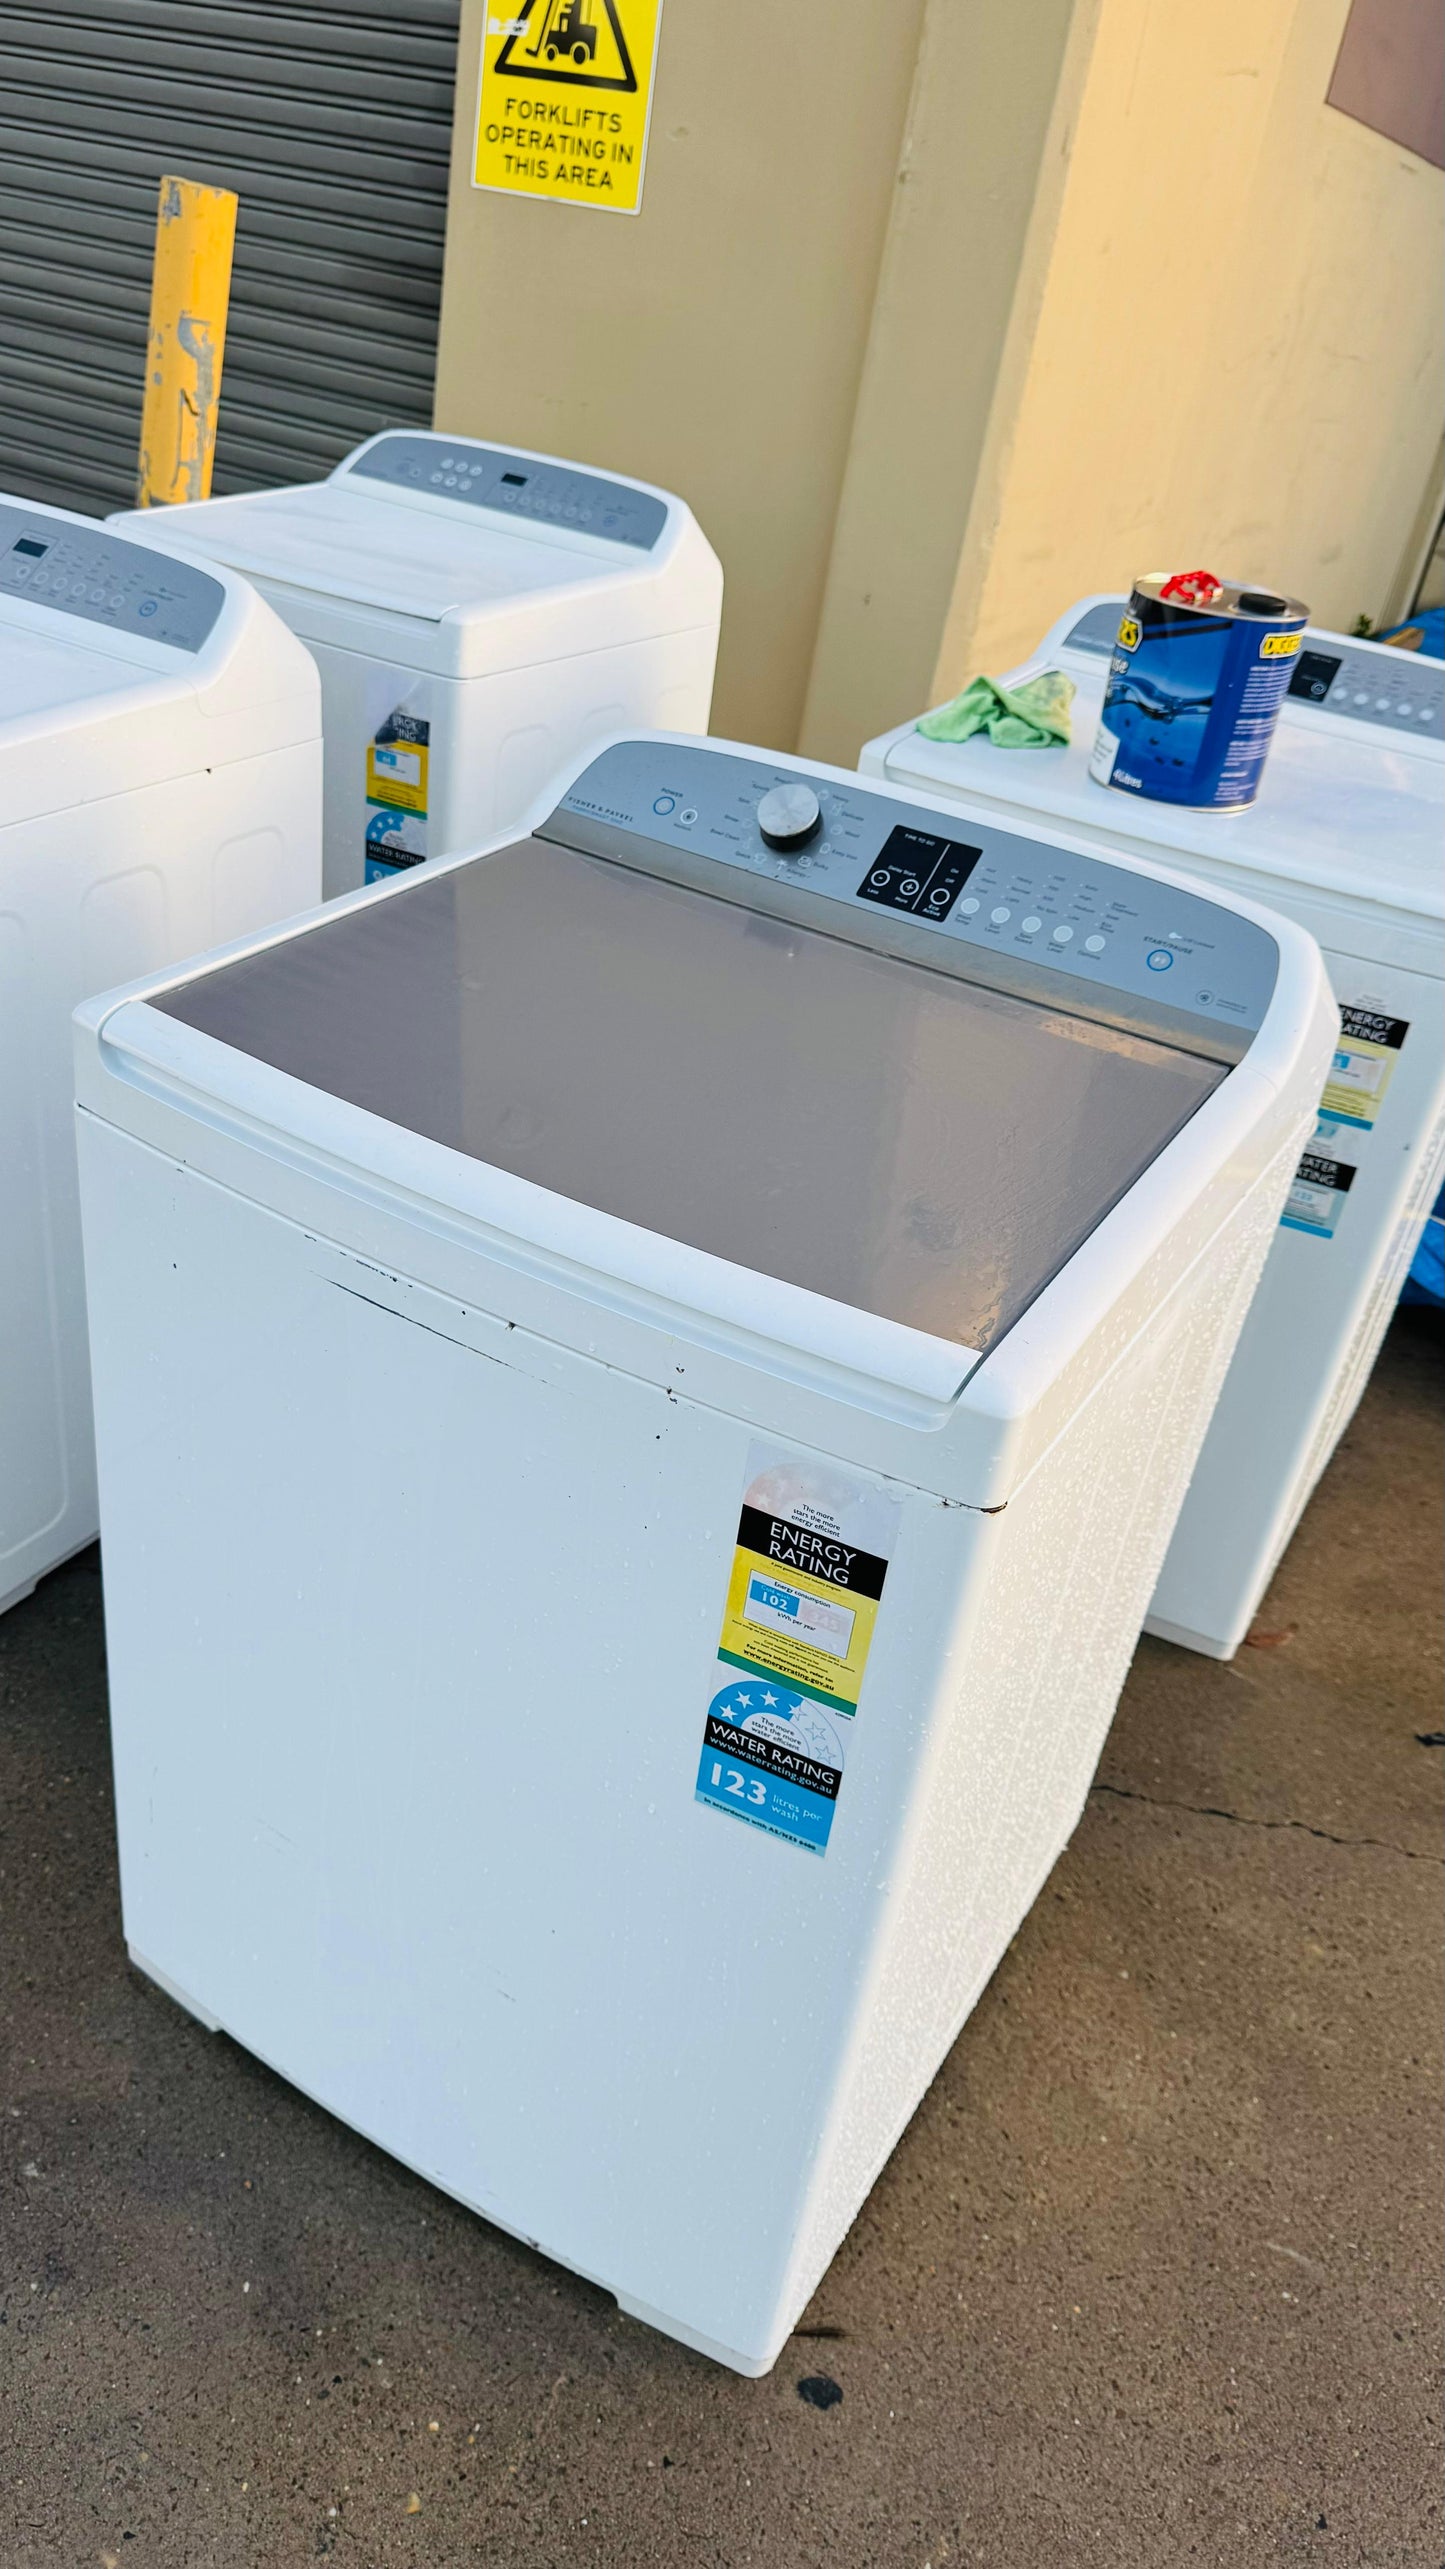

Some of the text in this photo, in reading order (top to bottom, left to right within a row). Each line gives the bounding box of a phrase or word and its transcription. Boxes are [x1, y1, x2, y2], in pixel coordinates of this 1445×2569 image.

[504, 98, 622, 133] FORKLIFTS
[484, 124, 634, 164] OPERATING IN
[503, 154, 614, 190] THIS AREA
[661, 787, 684, 798] POWER
[904, 833, 918, 841] TIME
[903, 869, 917, 877] Start
[1341, 1024, 1388, 1044] ATING
[793, 1508, 841, 1531] stars the more
[802, 1503, 834, 1522] The more
[791, 1515, 840, 1538] energy efficient
[770, 1521, 858, 1566] ENERGY
[769, 1540, 850, 1584] RATING
[762, 1592, 788, 1610] 102
[774, 1581, 831, 1608] Energy consumption
[778, 1613, 792, 1622] kWh
[792, 1619, 803, 1627] per
[742, 1648, 835, 1691] www.energyrating.gov.au
[756, 1648, 772, 1657] more
[772, 1654, 808, 1673] information,
[808, 1670, 824, 1679] refer
[711, 1721, 767, 1756] WATER
[751, 1720, 802, 1745] stars the more
[751, 1726, 800, 1751] water efficient
[760, 1716, 795, 1736] The more
[710, 1735, 833, 1795] www.waterrating.gov.au
[771, 1749, 835, 1785] RATING
[710, 1762, 768, 1806] 123
[712, 1801, 750, 1822] accordance
[751, 1819, 767, 1830] with
[771, 1805, 799, 1822] wash
[772, 1794, 823, 1822] litres per
